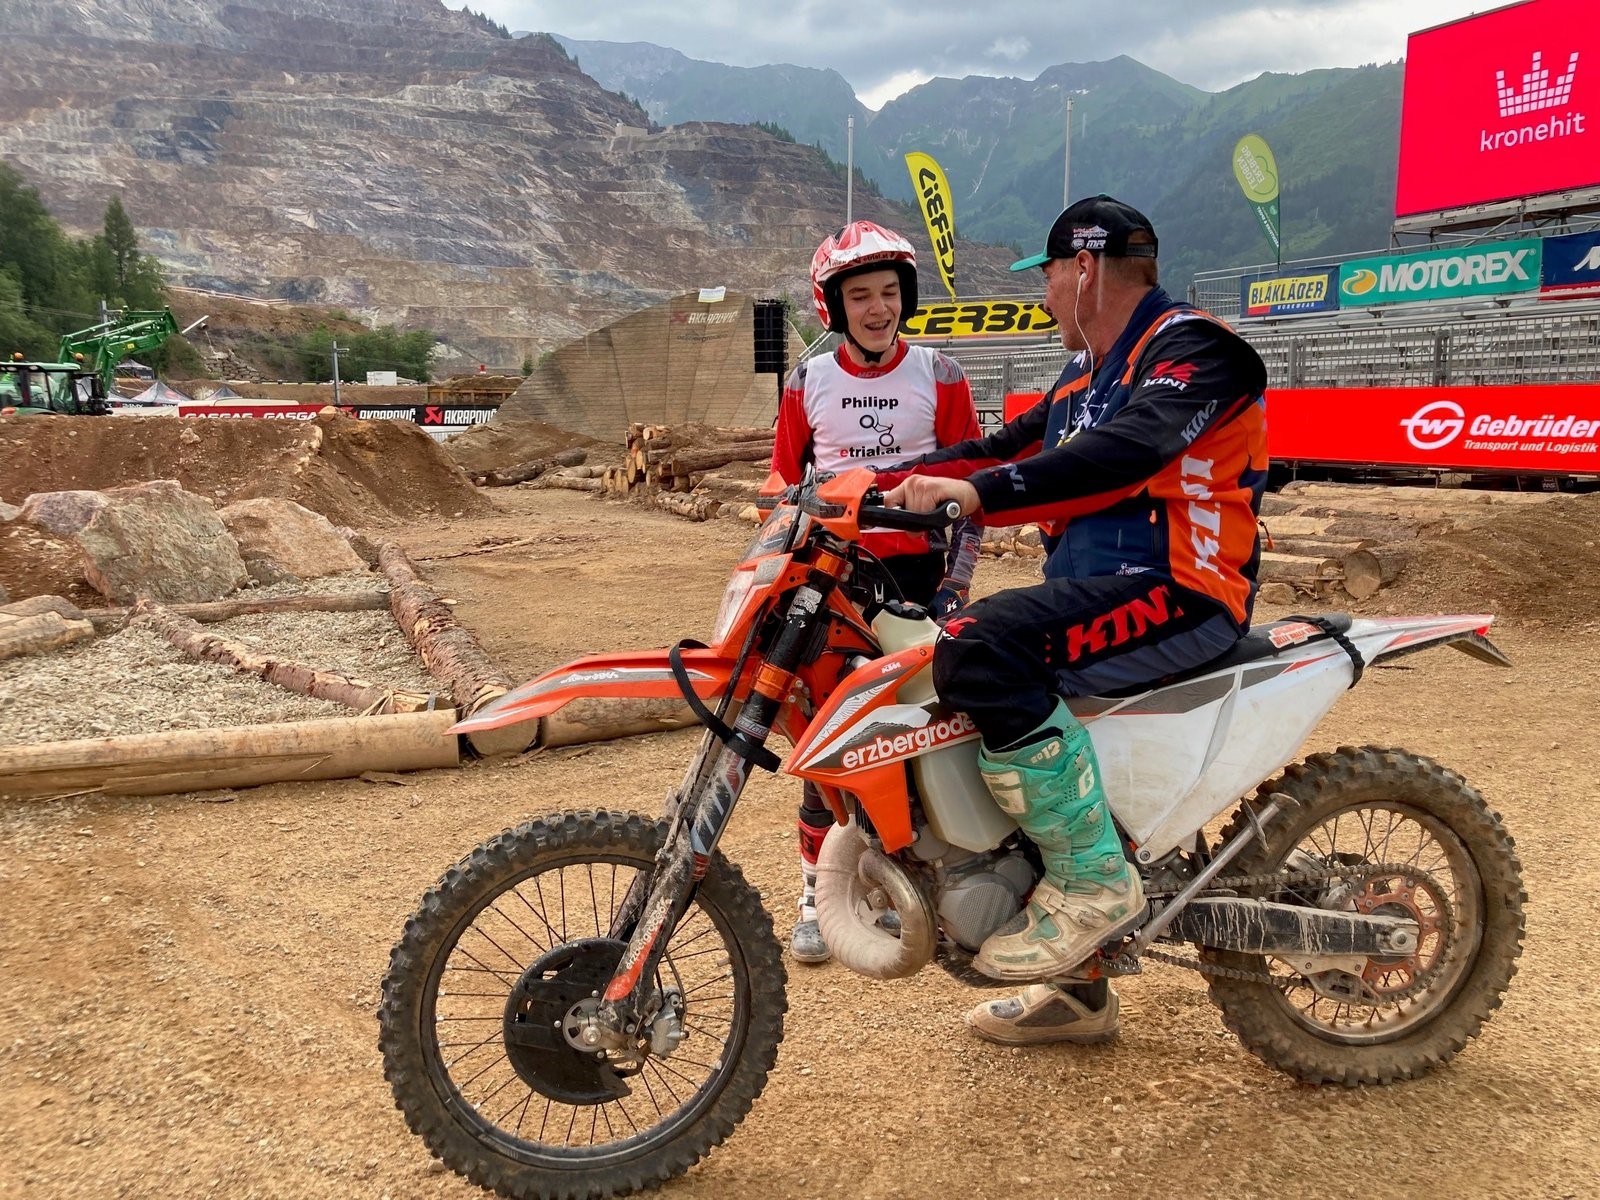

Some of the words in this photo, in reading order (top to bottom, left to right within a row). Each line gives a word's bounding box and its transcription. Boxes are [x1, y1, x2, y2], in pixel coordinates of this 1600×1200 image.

[1480, 112, 1585, 151] kronehit
[1379, 249, 1529, 293] MOTOREX
[1252, 279, 1324, 305] BLÅKLÄDER
[1142, 377, 1188, 391] KINI
[842, 396, 899, 409] Philipp
[1469, 414, 1600, 438] Gebrüder
[840, 445, 902, 458] etrial.at
[1464, 440, 1516, 452] Transport
[1520, 443, 1544, 451] und
[1546, 442, 1598, 454] Logistik
